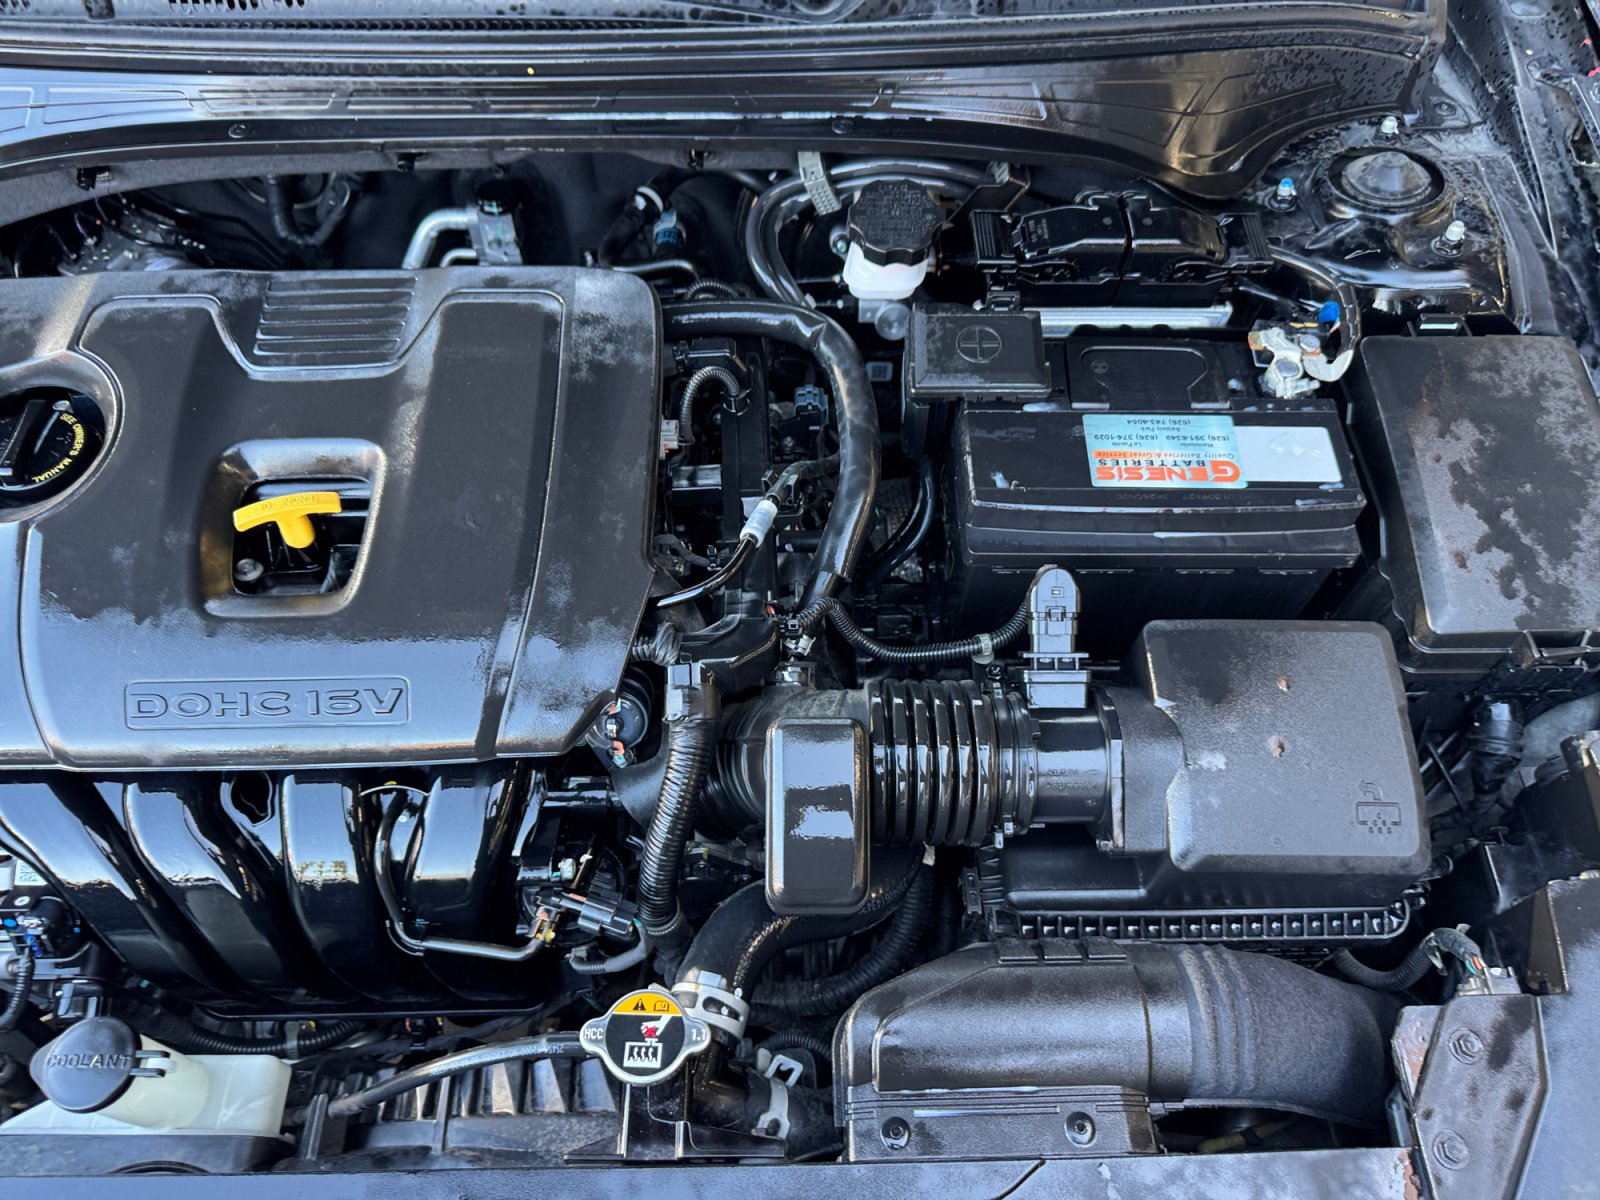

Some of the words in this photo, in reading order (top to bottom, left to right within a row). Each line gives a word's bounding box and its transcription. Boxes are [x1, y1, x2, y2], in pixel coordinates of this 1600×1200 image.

[60, 413, 77, 425] SEE
[69, 424, 85, 456] OWNER'S
[1204, 452, 1234, 460] Quality
[32, 457, 72, 483] MANUAL
[1095, 460, 1241, 483] GENESIS
[129, 690, 290, 718] DOHC
[306, 687, 403, 716] 16V
[584, 1028, 604, 1039] HCC
[691, 1029, 706, 1041] 1.1
[46, 1053, 131, 1069] COOLANT
